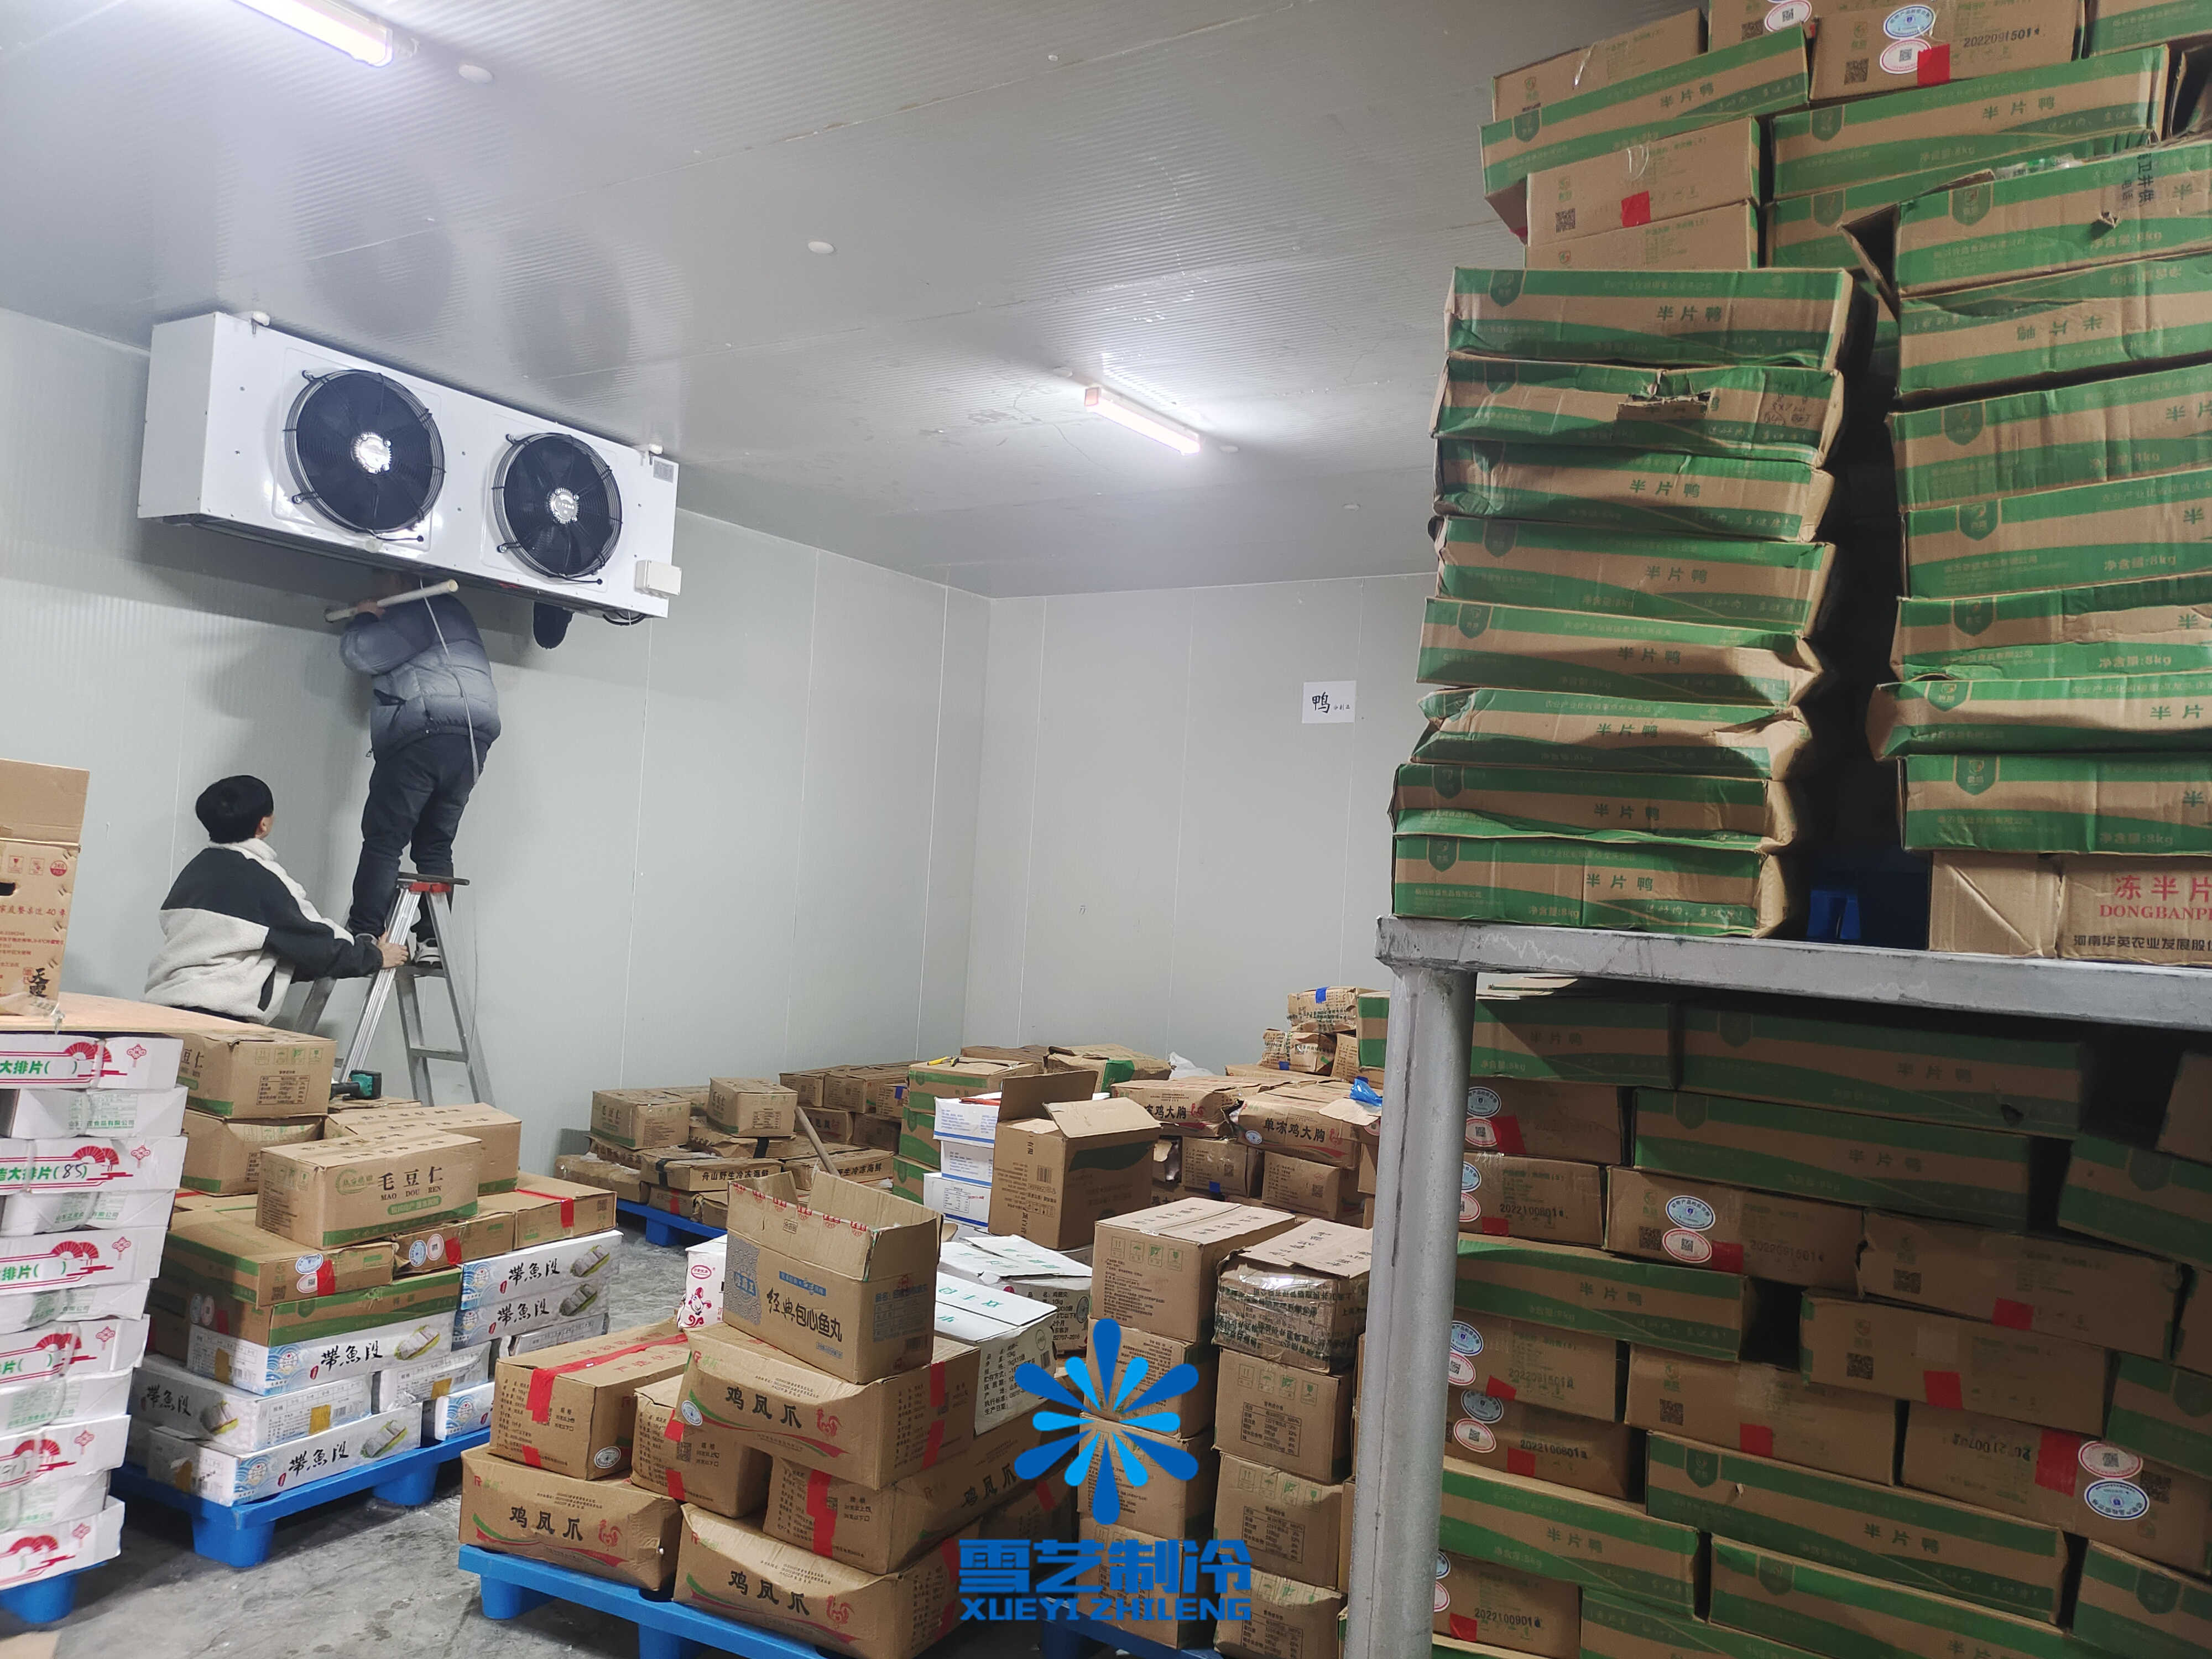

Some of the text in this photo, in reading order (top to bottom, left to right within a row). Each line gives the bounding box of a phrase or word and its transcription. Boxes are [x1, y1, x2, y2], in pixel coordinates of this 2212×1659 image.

[1660, 82, 1714, 108] 半片鸭
[1982, 96, 2056, 119] 半片鸭
[1657, 305, 1722, 322] 半片鸭
[1630, 479, 1700, 498] 半片鸭
[2183, 508, 2205, 525] 半
[1646, 565, 1708, 584] 半片鸭
[1618, 647, 1681, 665] 半片鸭
[1312, 691, 1330, 713] 鸭
[1597, 722, 1658, 739] 半片鸭
[1594, 802, 1660, 822] 半片鸭
[1585, 873, 1653, 891] 半片鸭
[1263, 1118, 1326, 1144] 单冻鸡大胸
[378, 1165, 445, 1192] 毛豆仁
[702, 1169, 770, 1181] 舟山野生冷冻海鲜
[380, 1185, 442, 1202] MAO DOU REN
[1579, 1281, 1642, 1306] 半片鸭
[766, 1286, 843, 1343] 经典包心鱼丸
[725, 1386, 802, 1429] 鸡凤爪
[509, 1506, 583, 1541] 鸡凤爪
[1548, 1527, 1603, 1553] 半片鸭
[728, 1571, 810, 1616] 鸡凤爪
